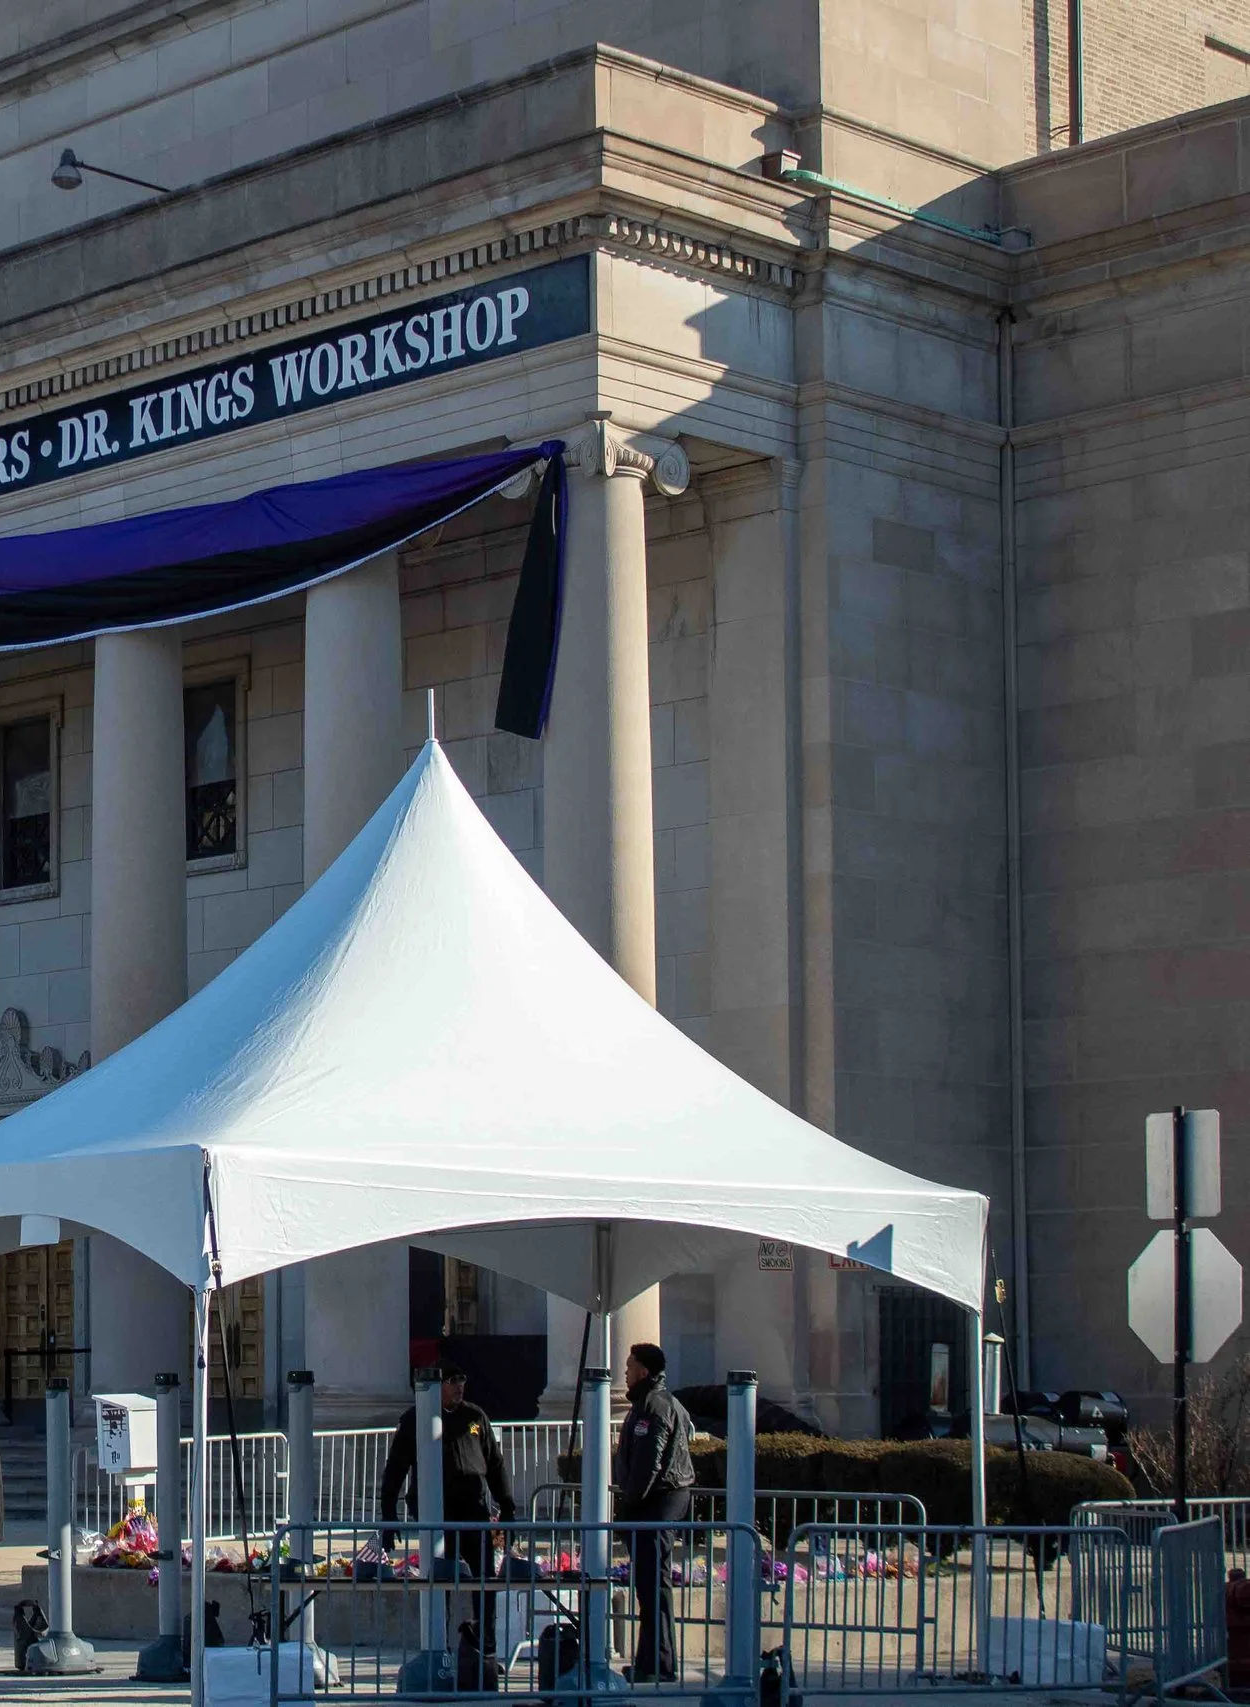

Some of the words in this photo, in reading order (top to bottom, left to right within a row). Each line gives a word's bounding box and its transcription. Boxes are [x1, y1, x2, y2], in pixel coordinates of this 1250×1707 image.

[57, 409, 120, 468] DR.
[129, 364, 255, 448] KINGS
[268, 286, 530, 407] WORKSHOP
[761, 1242, 775, 1255] NO
[761, 1258, 790, 1267] SMOKING
